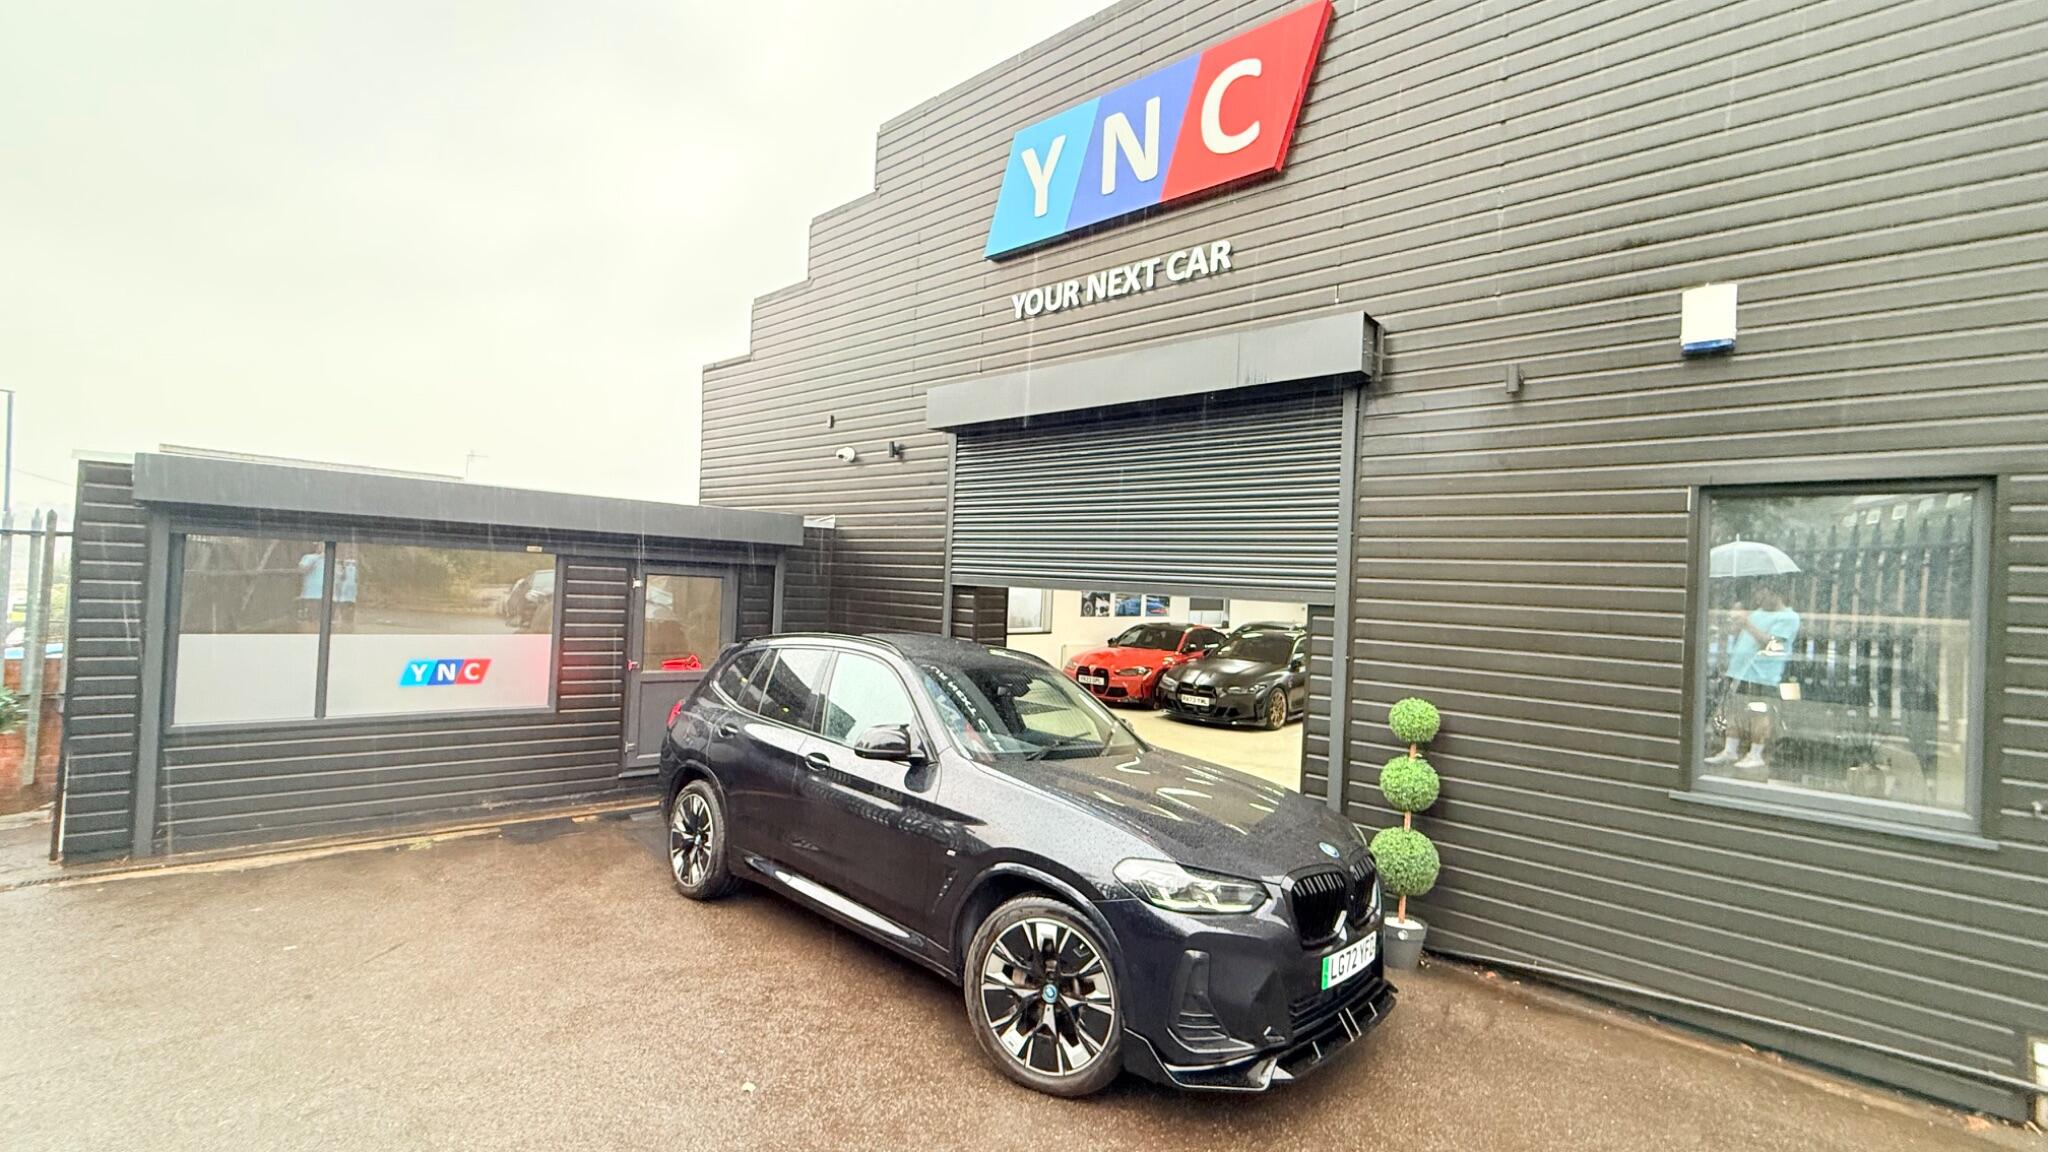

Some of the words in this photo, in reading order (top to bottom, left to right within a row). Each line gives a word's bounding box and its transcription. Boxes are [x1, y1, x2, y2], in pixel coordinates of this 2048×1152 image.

[1021, 58, 1262, 217] YNC
[1012, 280, 1080, 319] YOUR
[1087, 258, 1161, 301] NEXT
[1166, 240, 1232, 281] CAR
[410, 662, 480, 682] YNC
[1331, 947, 1358, 980] LG72
